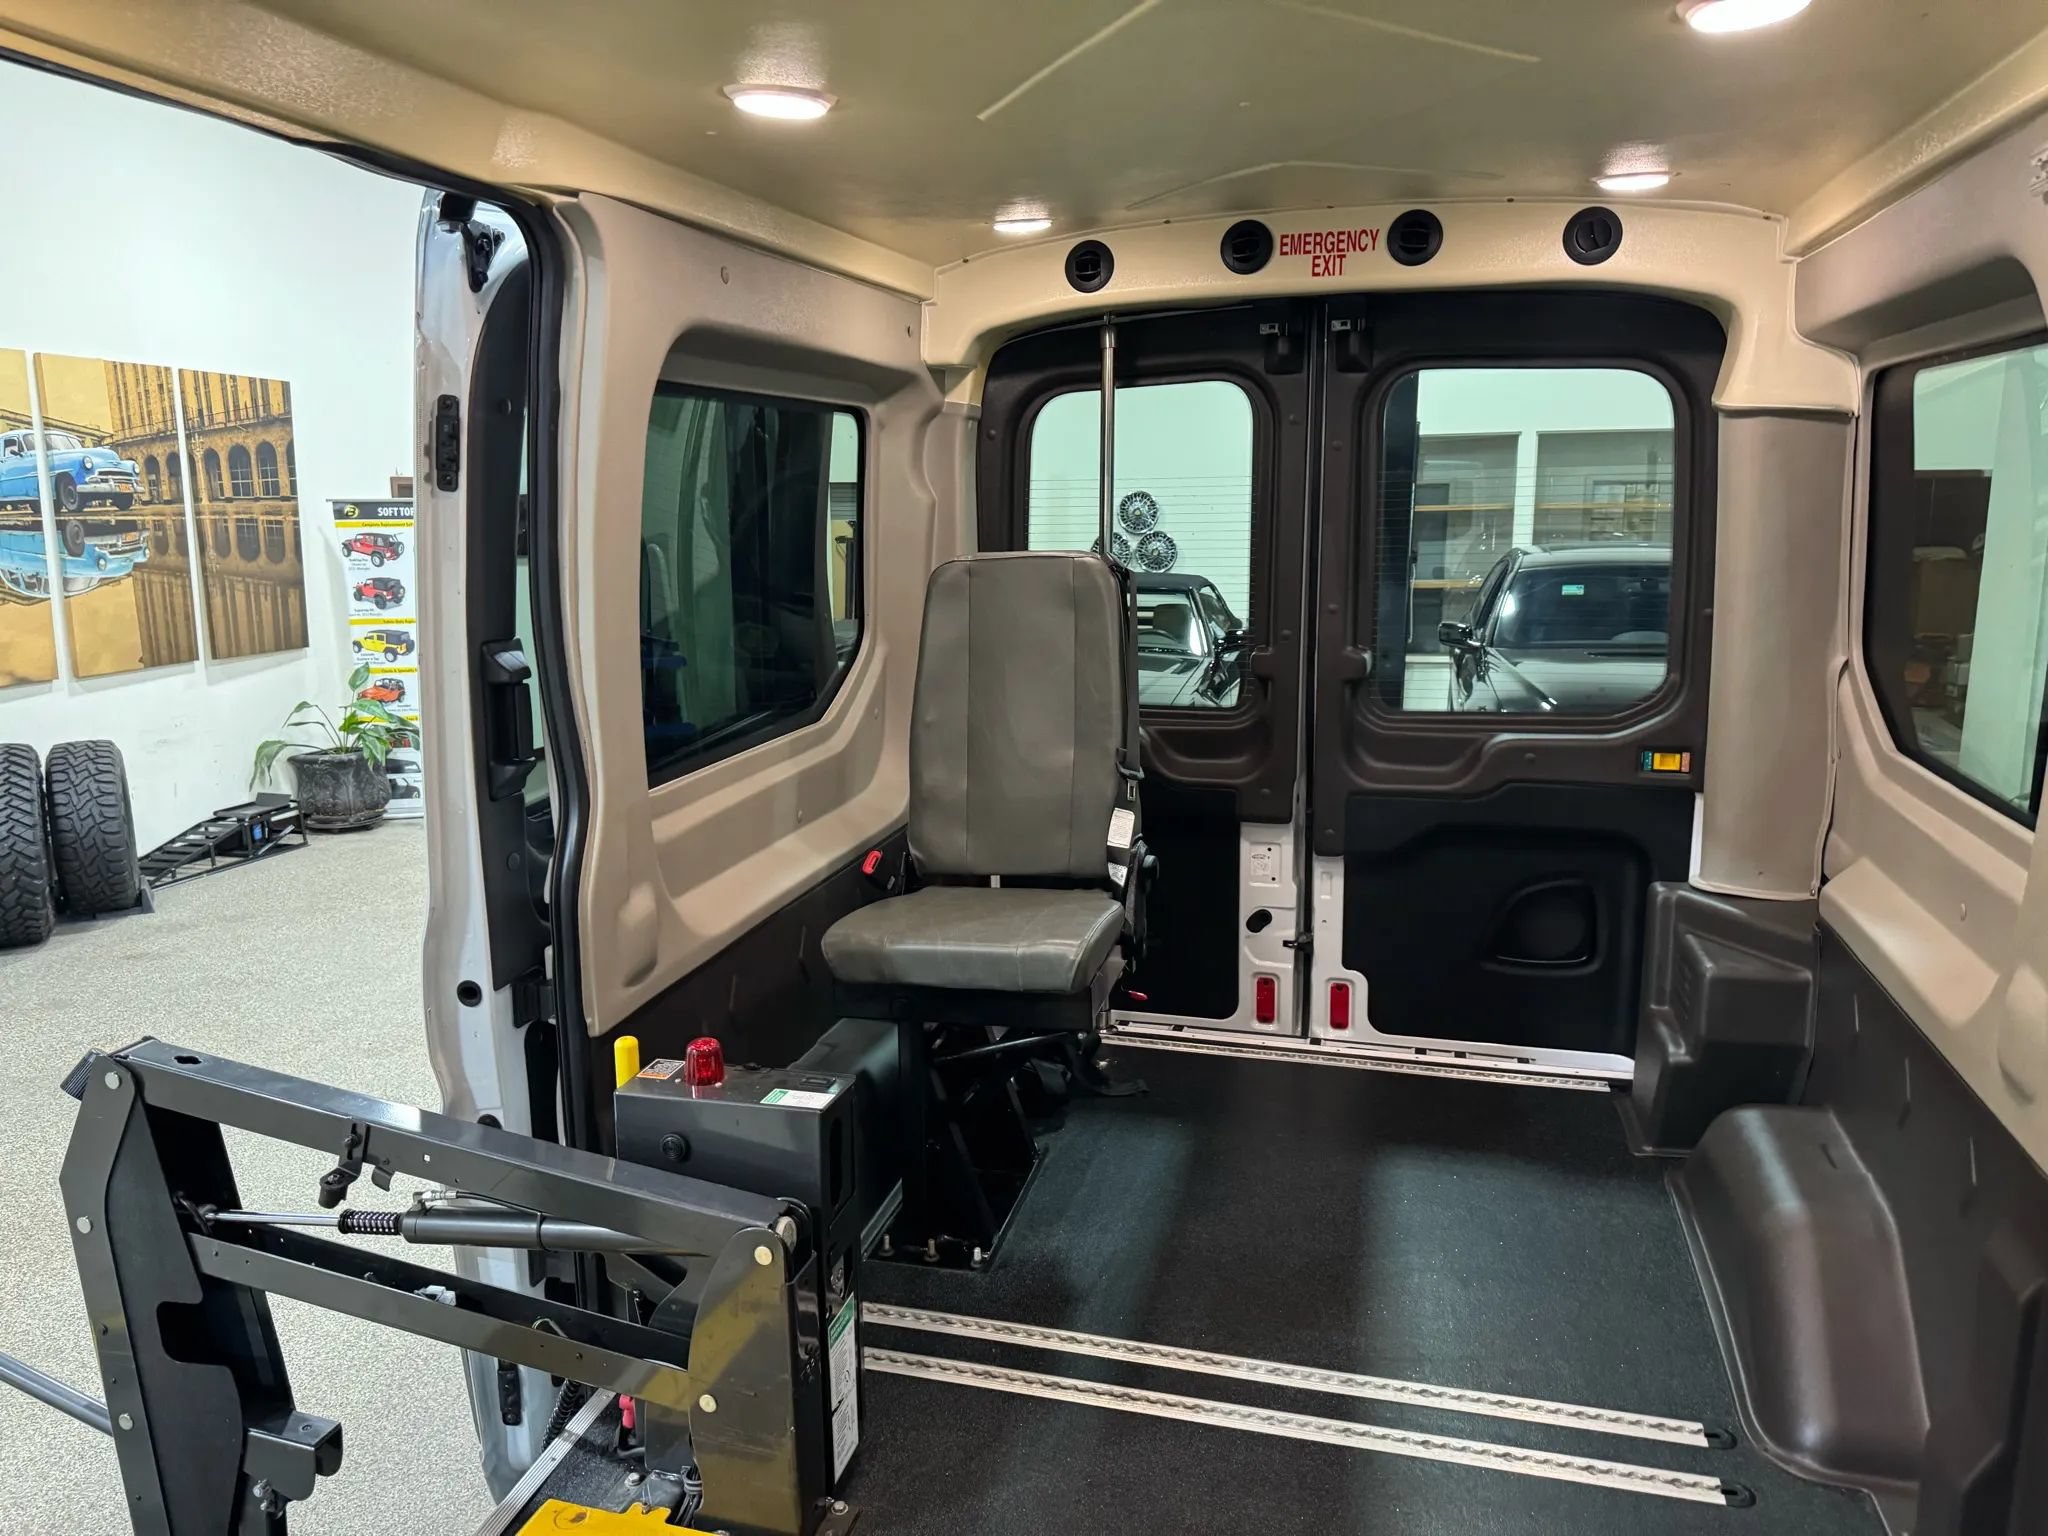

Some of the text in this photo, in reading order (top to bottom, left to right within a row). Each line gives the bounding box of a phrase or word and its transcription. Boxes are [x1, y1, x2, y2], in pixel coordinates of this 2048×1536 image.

[1279, 228, 1380, 256] EMERGENCY
[1311, 254, 1347, 277] EXIT
[377, 506, 398, 517] SOFT
